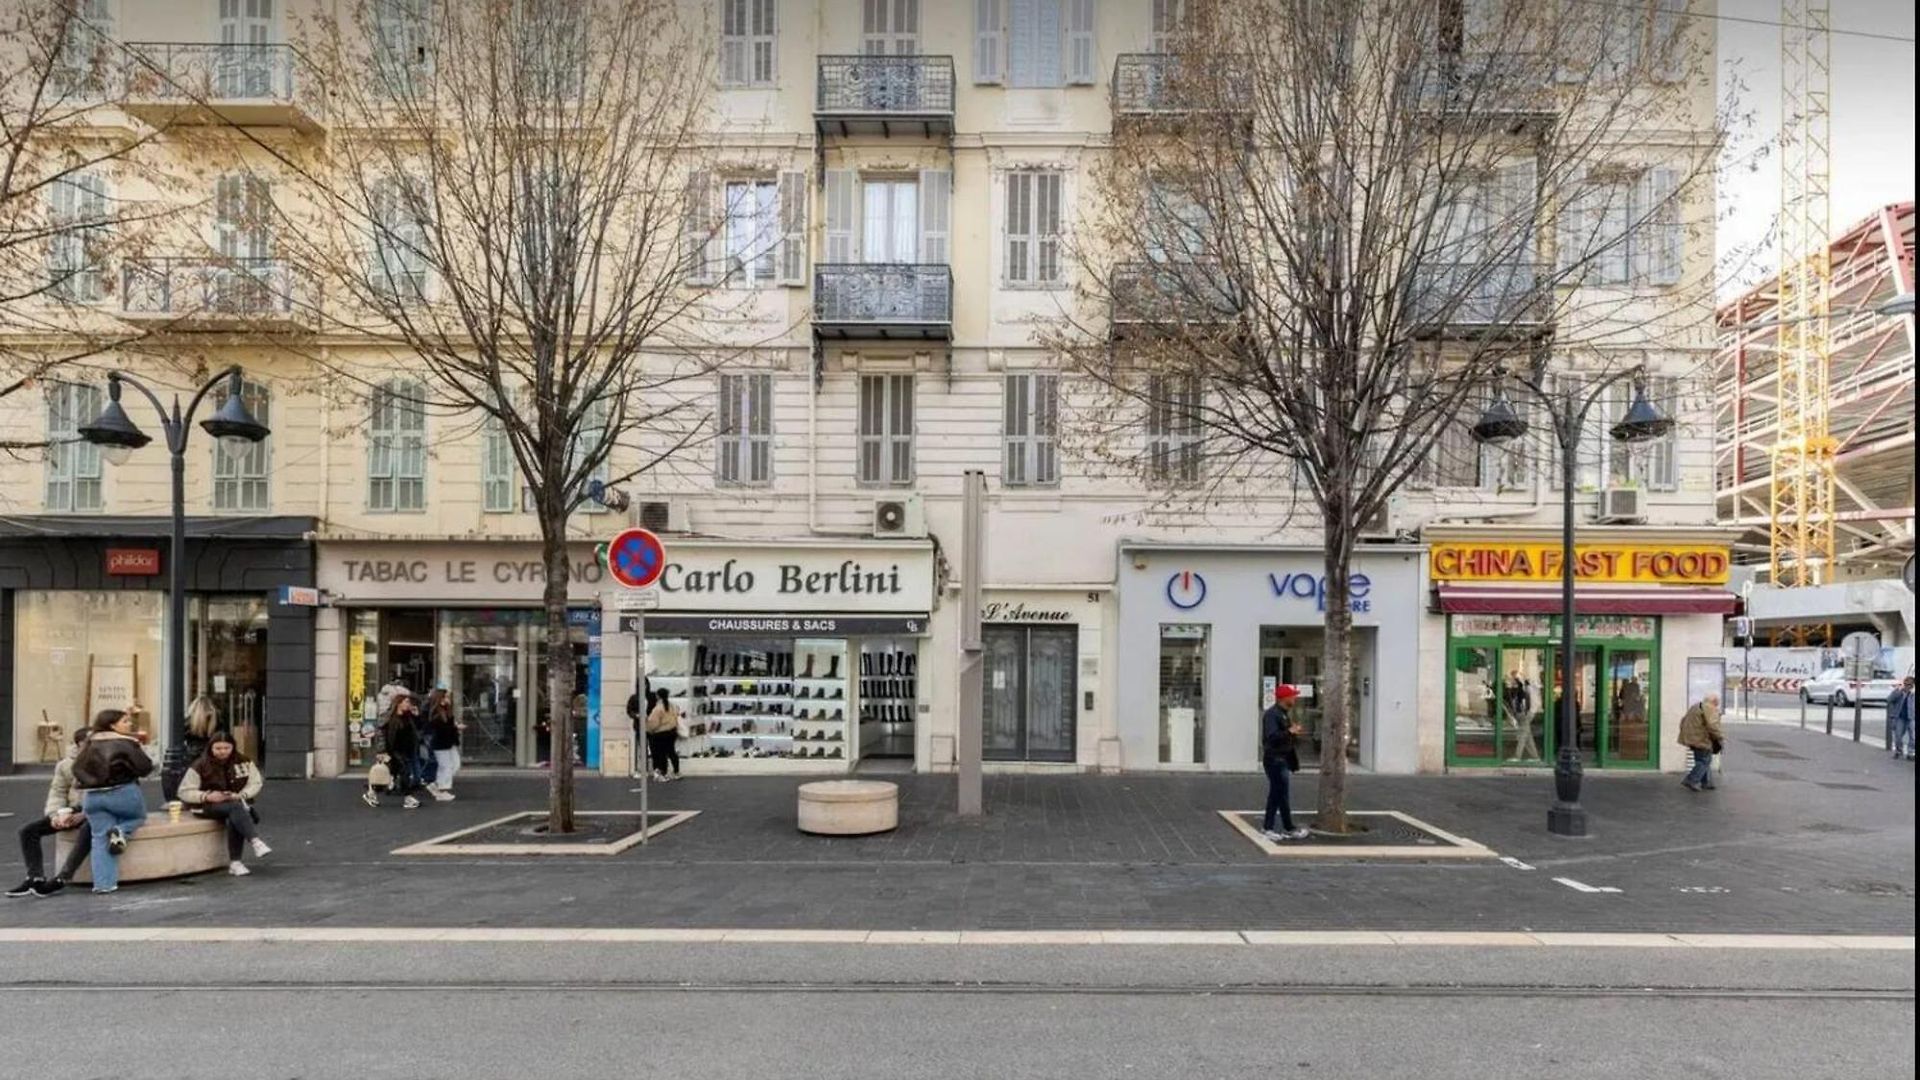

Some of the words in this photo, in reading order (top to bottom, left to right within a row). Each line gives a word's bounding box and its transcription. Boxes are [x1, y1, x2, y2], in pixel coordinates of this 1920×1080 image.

[342, 560, 428, 583] TABAC
[446, 560, 476, 583] LE
[493, 560, 603, 584] CYRNO
[1435, 549, 1532, 576] CHINA
[1540, 550, 1621, 578] FAST
[1632, 551, 1726, 579] FOOD
[659, 559, 754, 593] Carlo
[777, 560, 902, 594] Berlini
[1087, 591, 1100, 602] 51
[708, 619, 789, 631] CHAUSSURES
[793, 619, 801, 631] &
[803, 619, 836, 631] SACS
